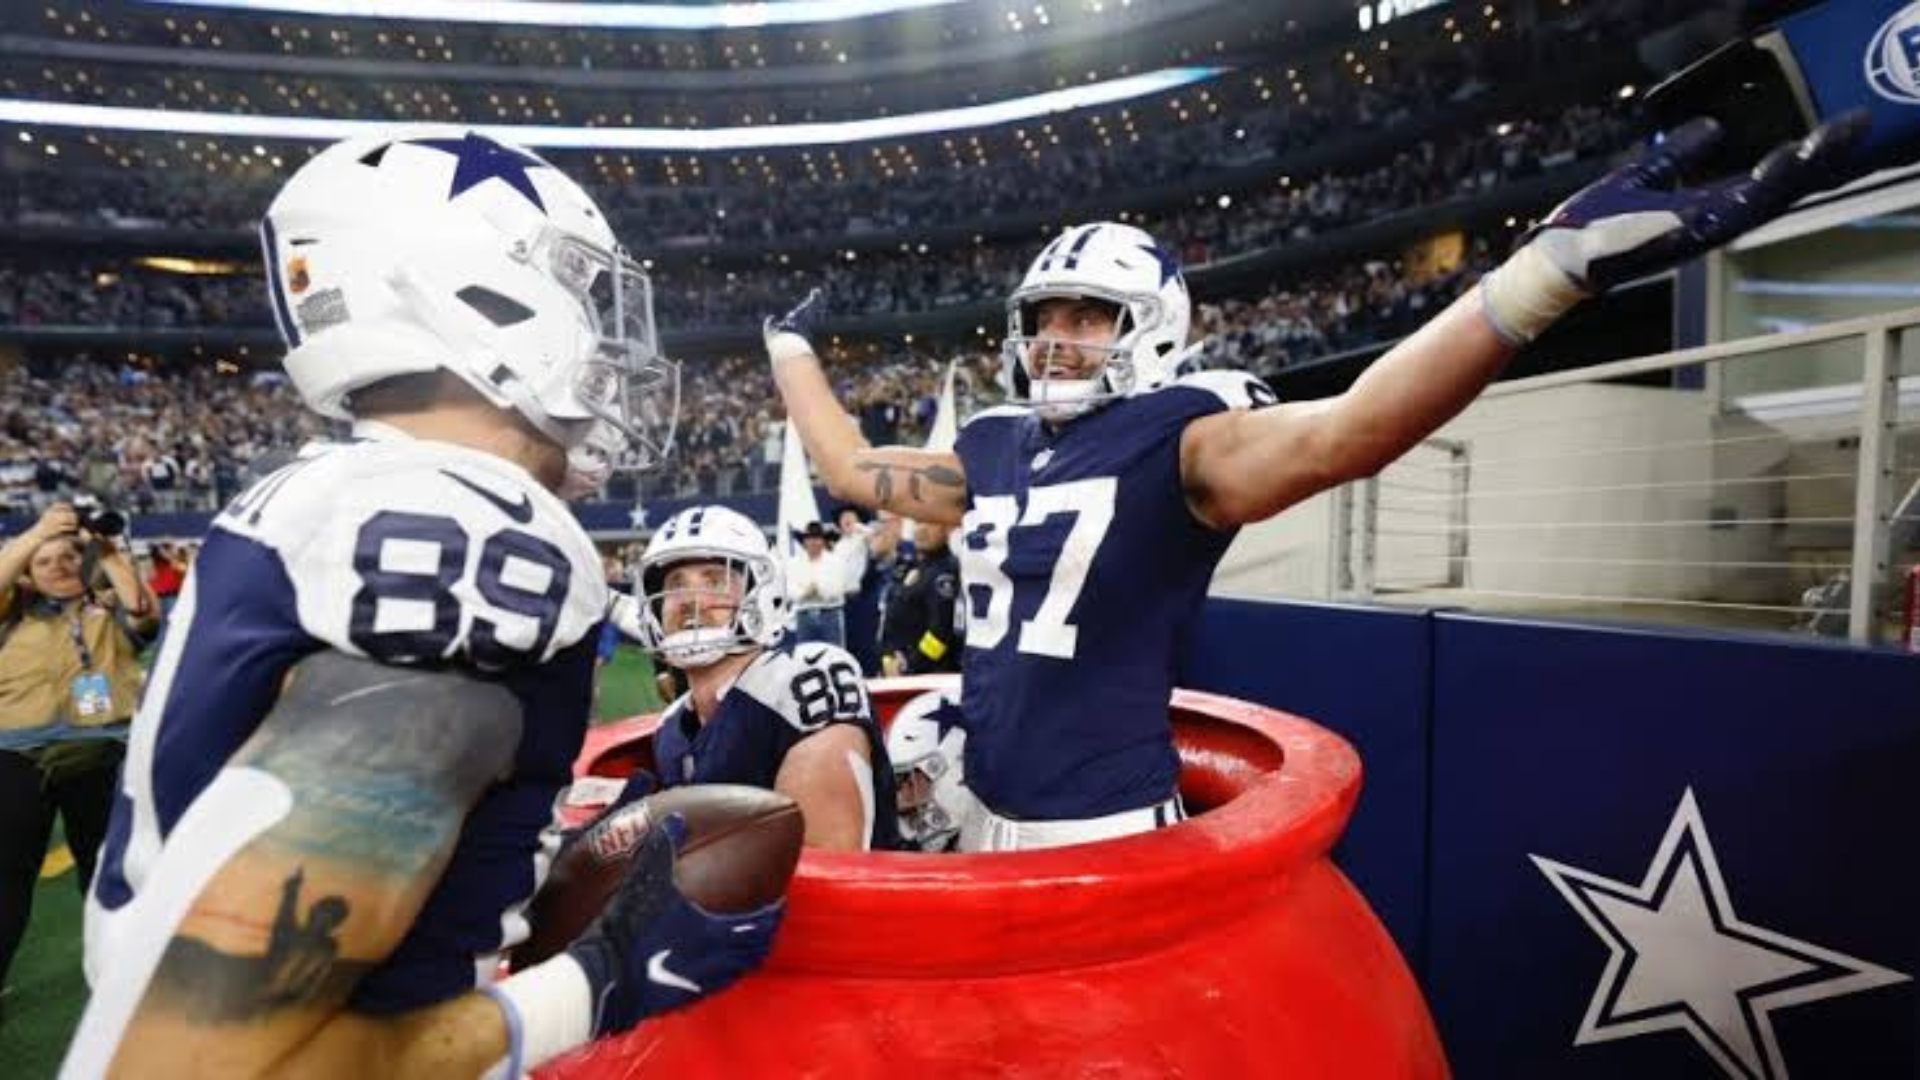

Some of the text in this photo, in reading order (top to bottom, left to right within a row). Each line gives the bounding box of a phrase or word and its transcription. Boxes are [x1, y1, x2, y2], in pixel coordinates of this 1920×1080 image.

[347, 510, 572, 671] 89
[962, 476, 1118, 660] 87
[790, 663, 862, 726] 86
[598, 816, 650, 853] NFL
